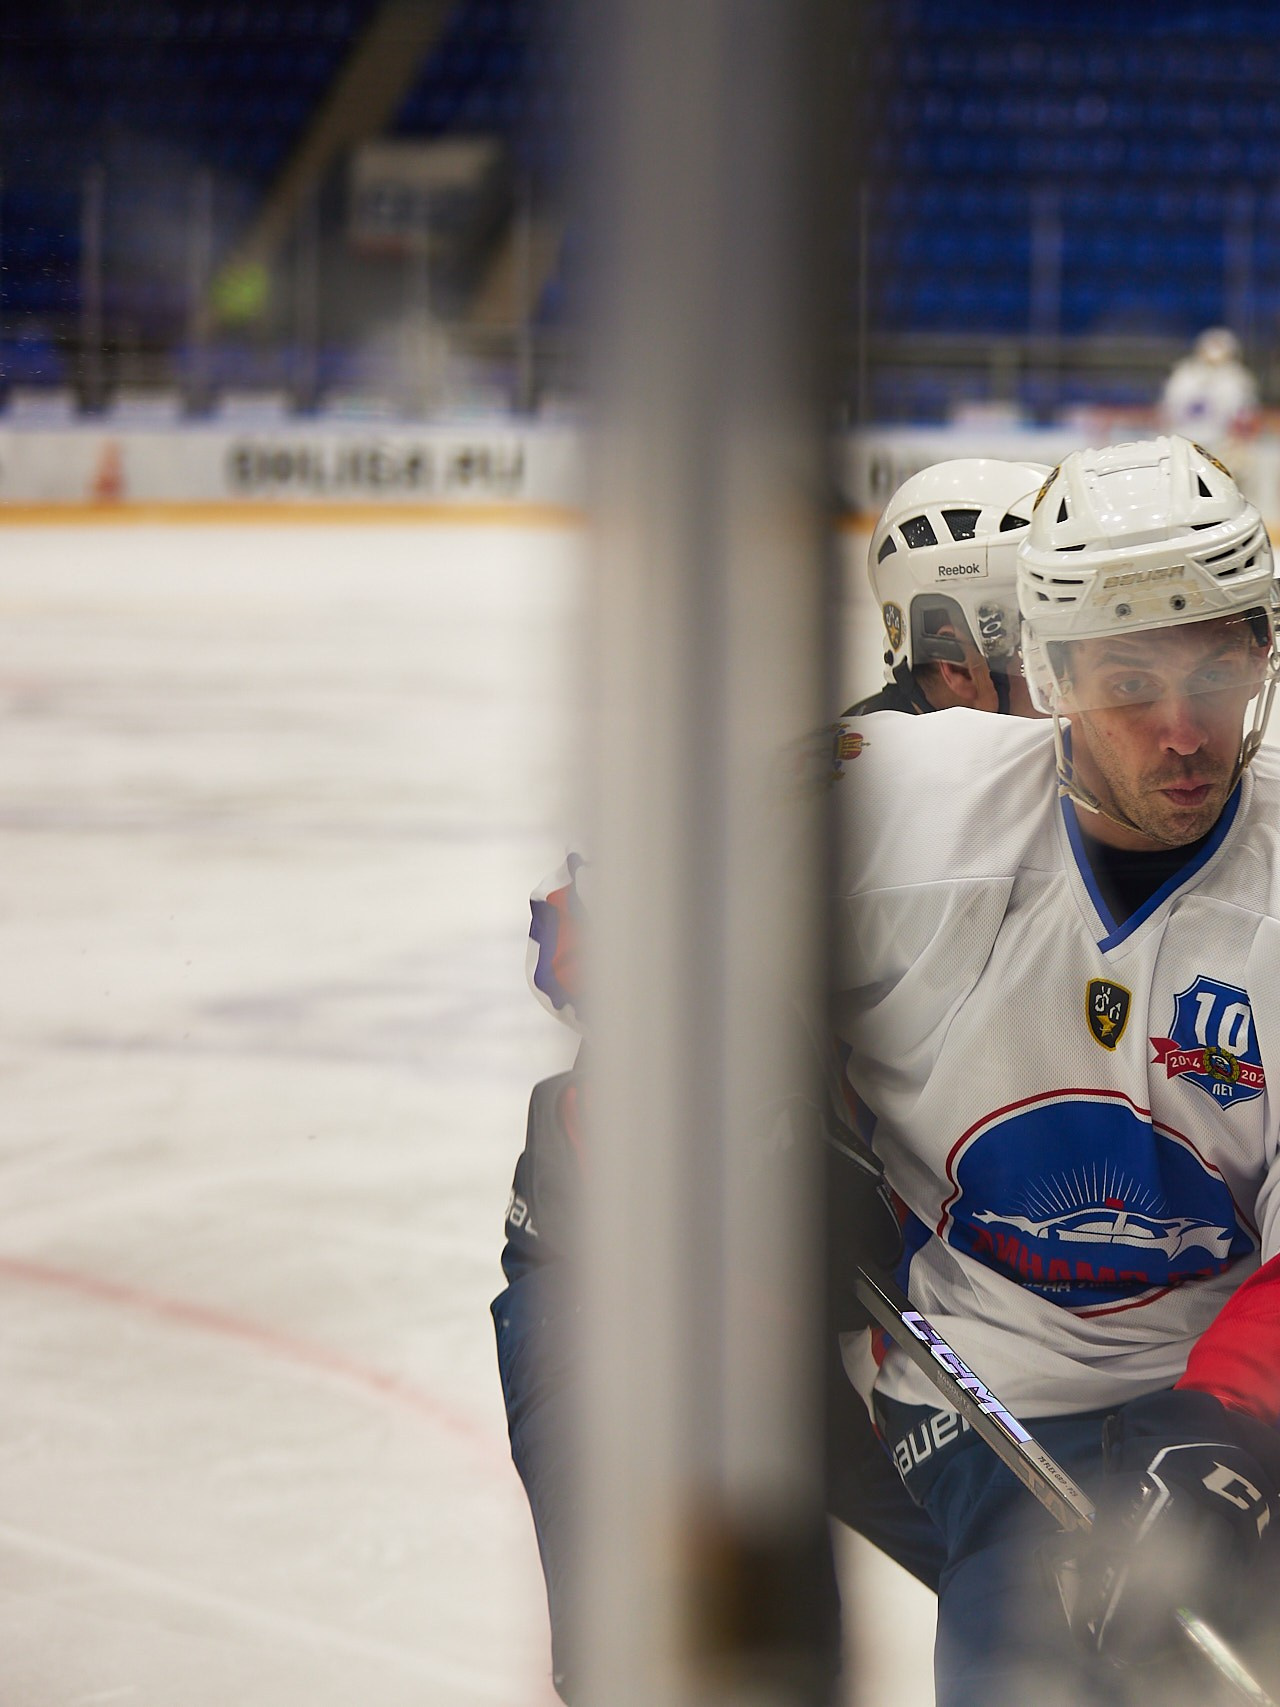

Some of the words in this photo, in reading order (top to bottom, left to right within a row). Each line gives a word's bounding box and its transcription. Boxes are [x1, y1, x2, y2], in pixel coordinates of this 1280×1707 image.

[938, 563, 980, 576] Reebok
[1195, 992, 1251, 1057] 10
[1170, 1056, 1201, 1068] 2014
[1241, 1069, 1265, 1084] 202
[1212, 1083, 1234, 1096] ЛЕТ
[902, 1312, 1008, 1415] CCM
[1043, 1462, 1056, 1474] FLEX
[1054, 1472, 1067, 1485] GRIP
